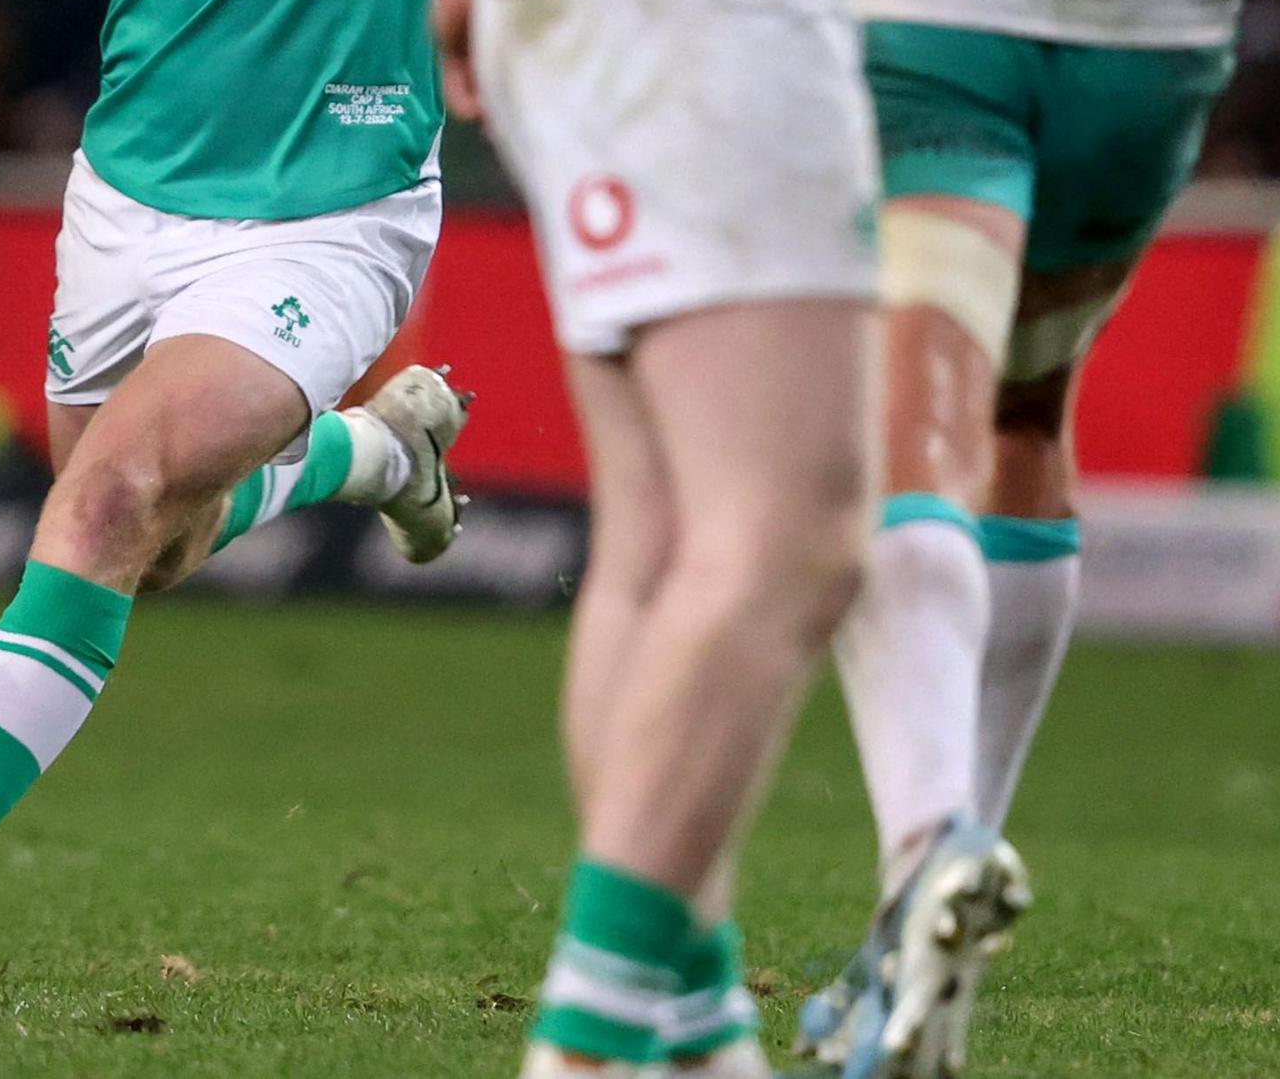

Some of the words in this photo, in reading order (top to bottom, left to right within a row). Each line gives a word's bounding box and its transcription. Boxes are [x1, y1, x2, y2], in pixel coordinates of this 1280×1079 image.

[351, 94, 373, 105] CAP
[328, 103, 364, 114] SOUTH
[365, 104, 405, 115] AFRICA
[273, 327, 302, 349] IRFU
